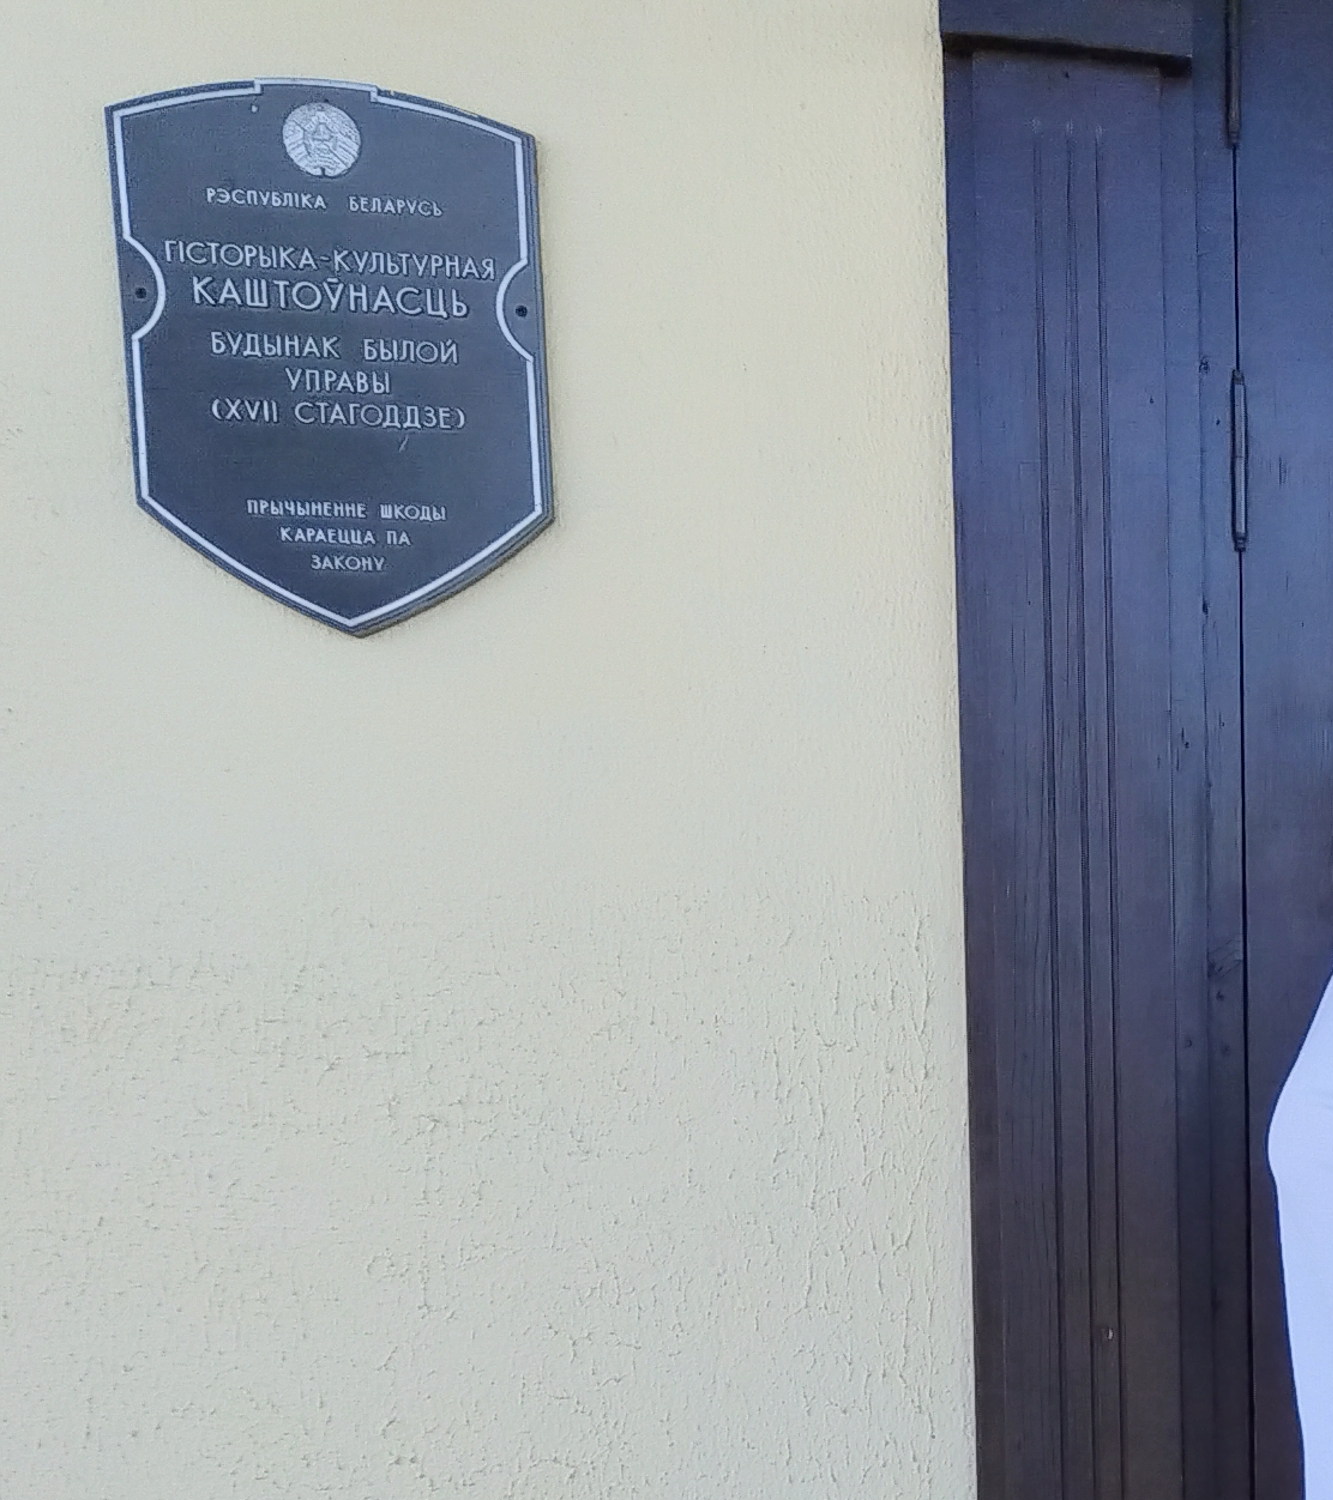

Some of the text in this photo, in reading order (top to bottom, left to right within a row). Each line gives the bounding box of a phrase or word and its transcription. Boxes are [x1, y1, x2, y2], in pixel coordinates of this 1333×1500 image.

[205, 186, 444, 218] РЭСПУБЛІКА БЕЛАРУСЬ
[164, 240, 496, 280] ГІСТОРЫКА-КУЛЬТУРНАЯ
[192, 277, 468, 319] КАШТОЎНАСЦЬ
[211, 331, 460, 365] БУДЫНАК БЫЛОЙ
[285, 367, 392, 395] УПРАВЫ
[294, 400, 467, 431] СТАГОДДЗЕ)
[245, 498, 448, 522] ПРЫЧЫНЕННЕ ШКОДЫ
[279, 525, 412, 547] КАРАЕЦЦА ПА
[310, 553, 385, 573] ЗАКОНУ
